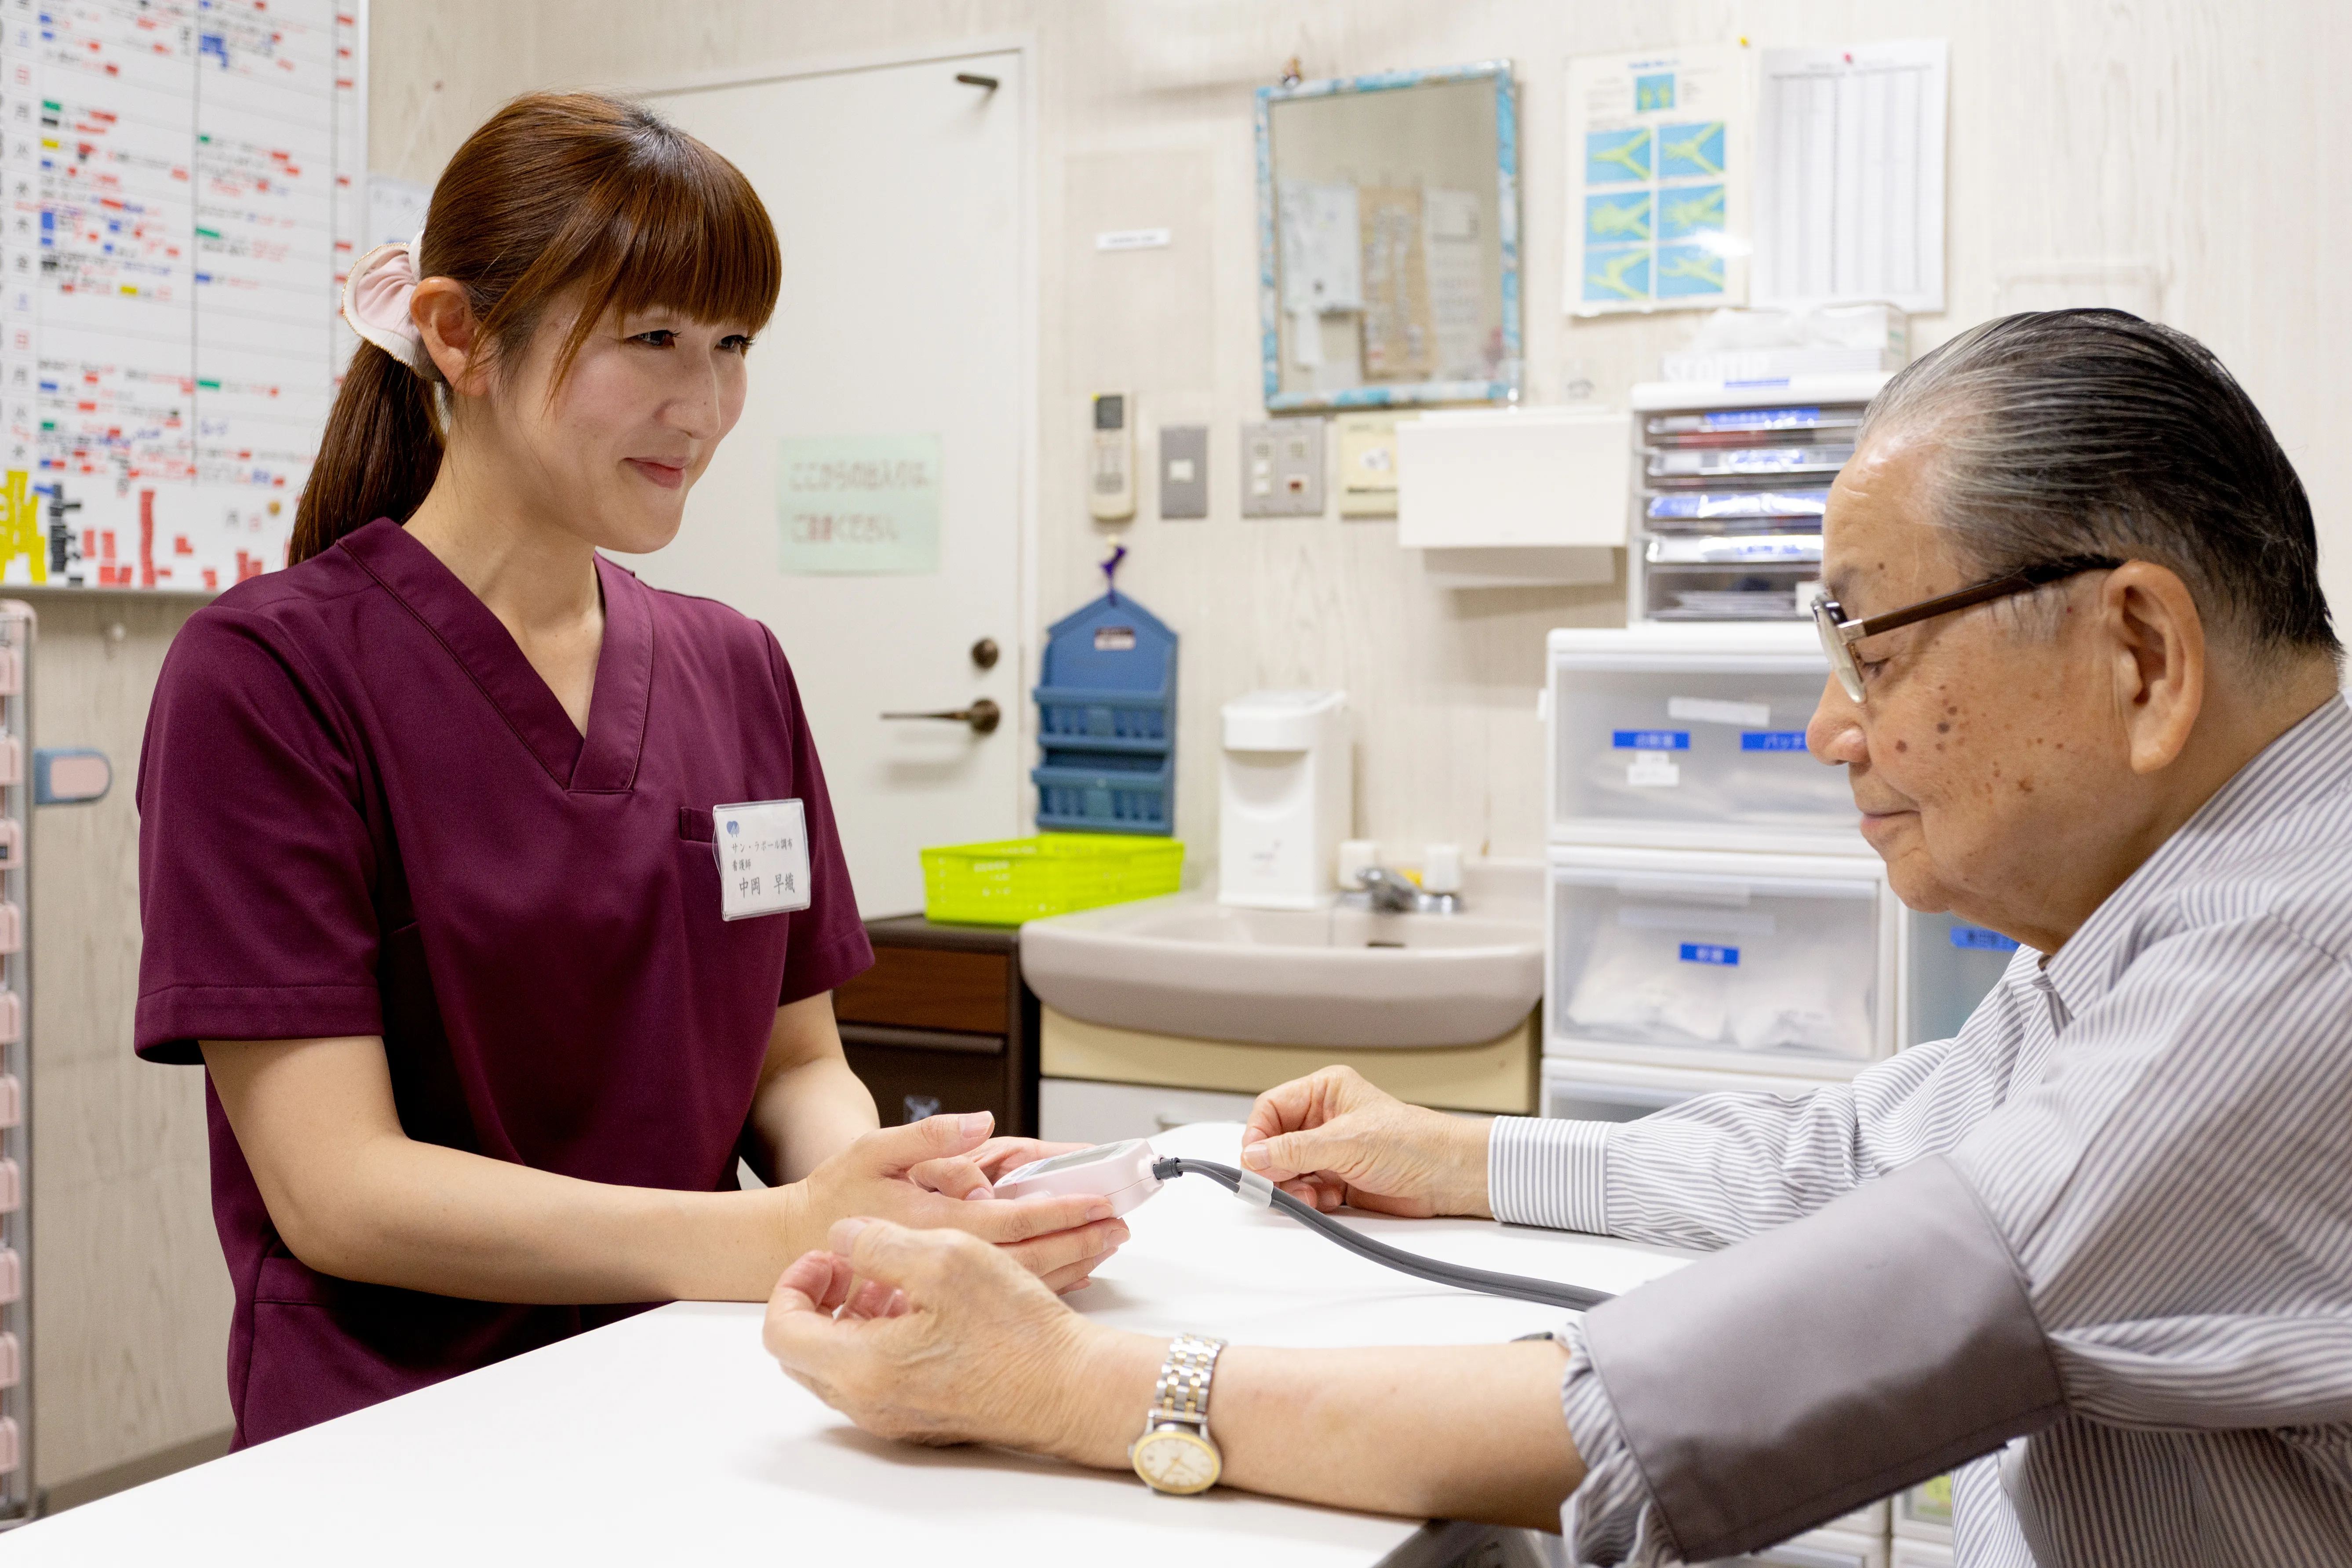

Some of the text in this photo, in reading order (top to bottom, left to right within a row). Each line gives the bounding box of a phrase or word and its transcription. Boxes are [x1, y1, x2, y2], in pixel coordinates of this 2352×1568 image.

[732, 859, 751, 872] 看護師
[739, 872, 795, 899] 中岡 早織
